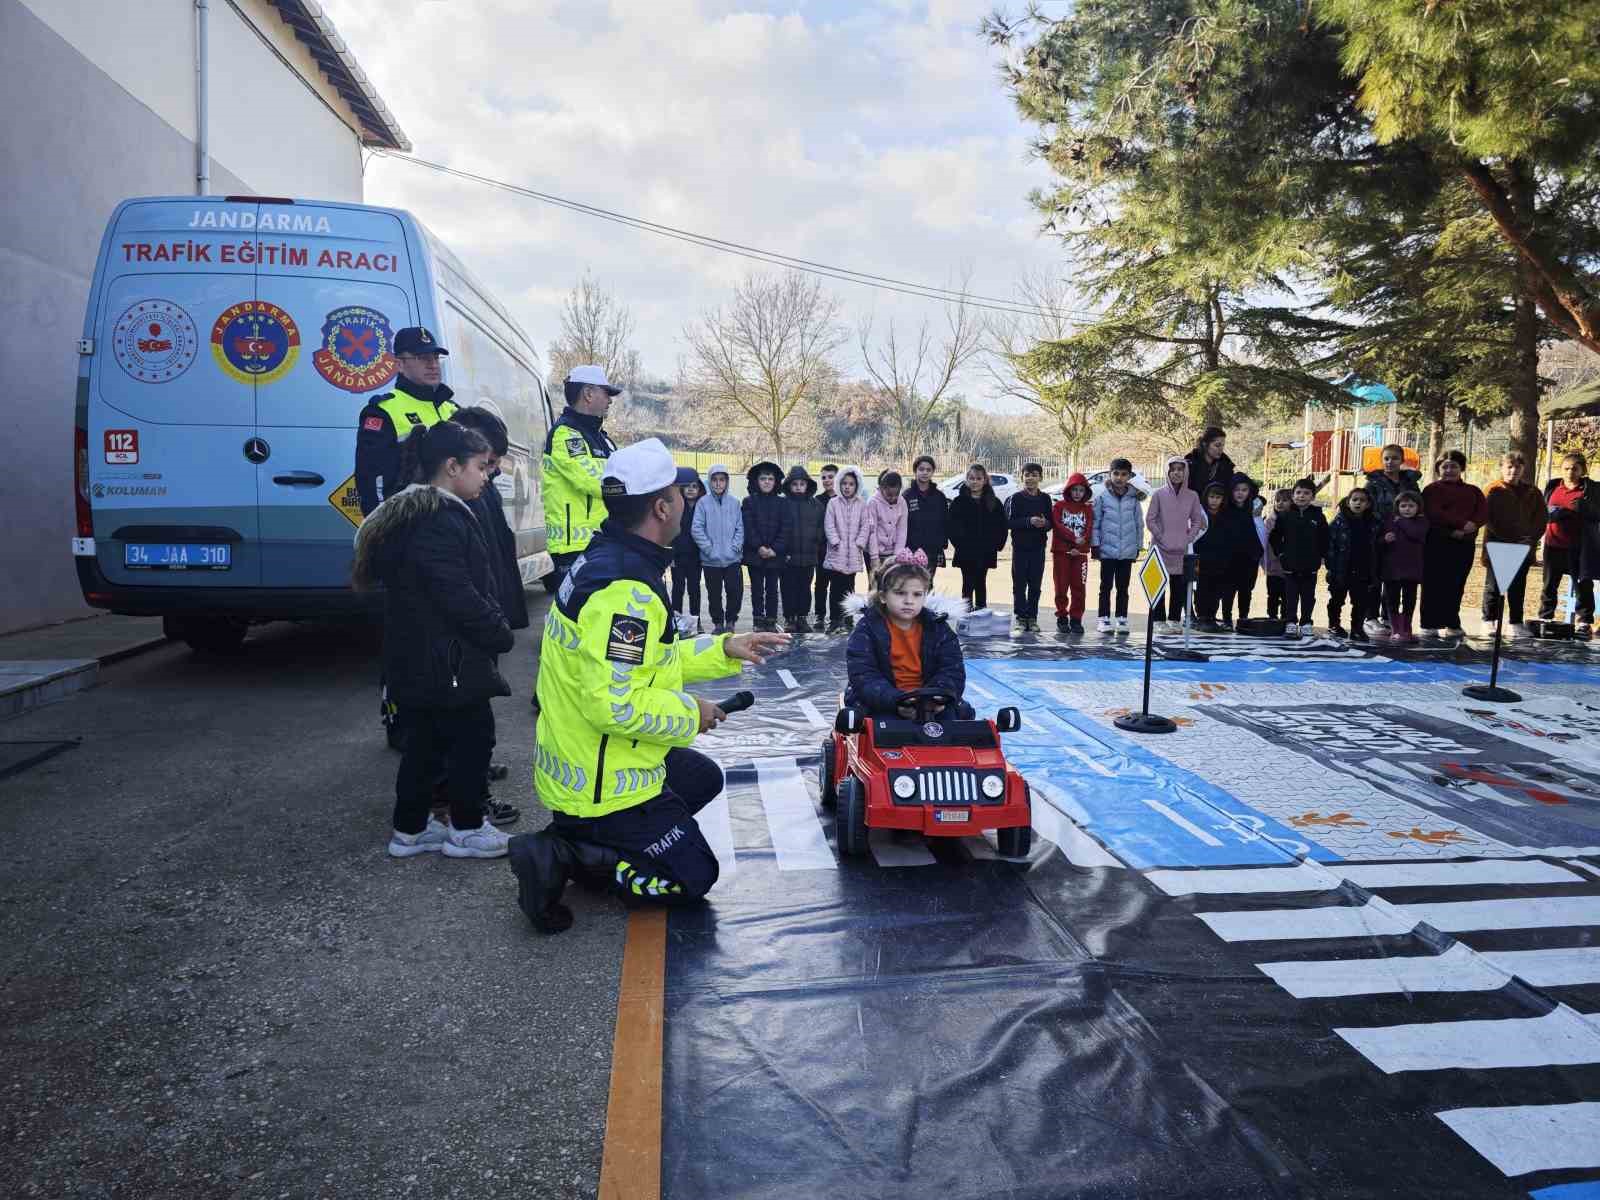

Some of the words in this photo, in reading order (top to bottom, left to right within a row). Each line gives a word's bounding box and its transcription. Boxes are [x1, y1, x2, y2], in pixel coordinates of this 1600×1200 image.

[189, 210, 331, 233] JANDARMA
[122, 240, 212, 262] TRAFİK
[220, 240, 308, 266] EĞİTİM
[317, 249, 398, 273] ARACI
[215, 303, 296, 337] JANDARMA
[319, 357, 395, 387] JANDARMA
[109, 433, 134, 451] 112
[131, 546, 148, 562] 34
[161, 546, 188, 562] JAA
[200, 547, 226, 563] 310
